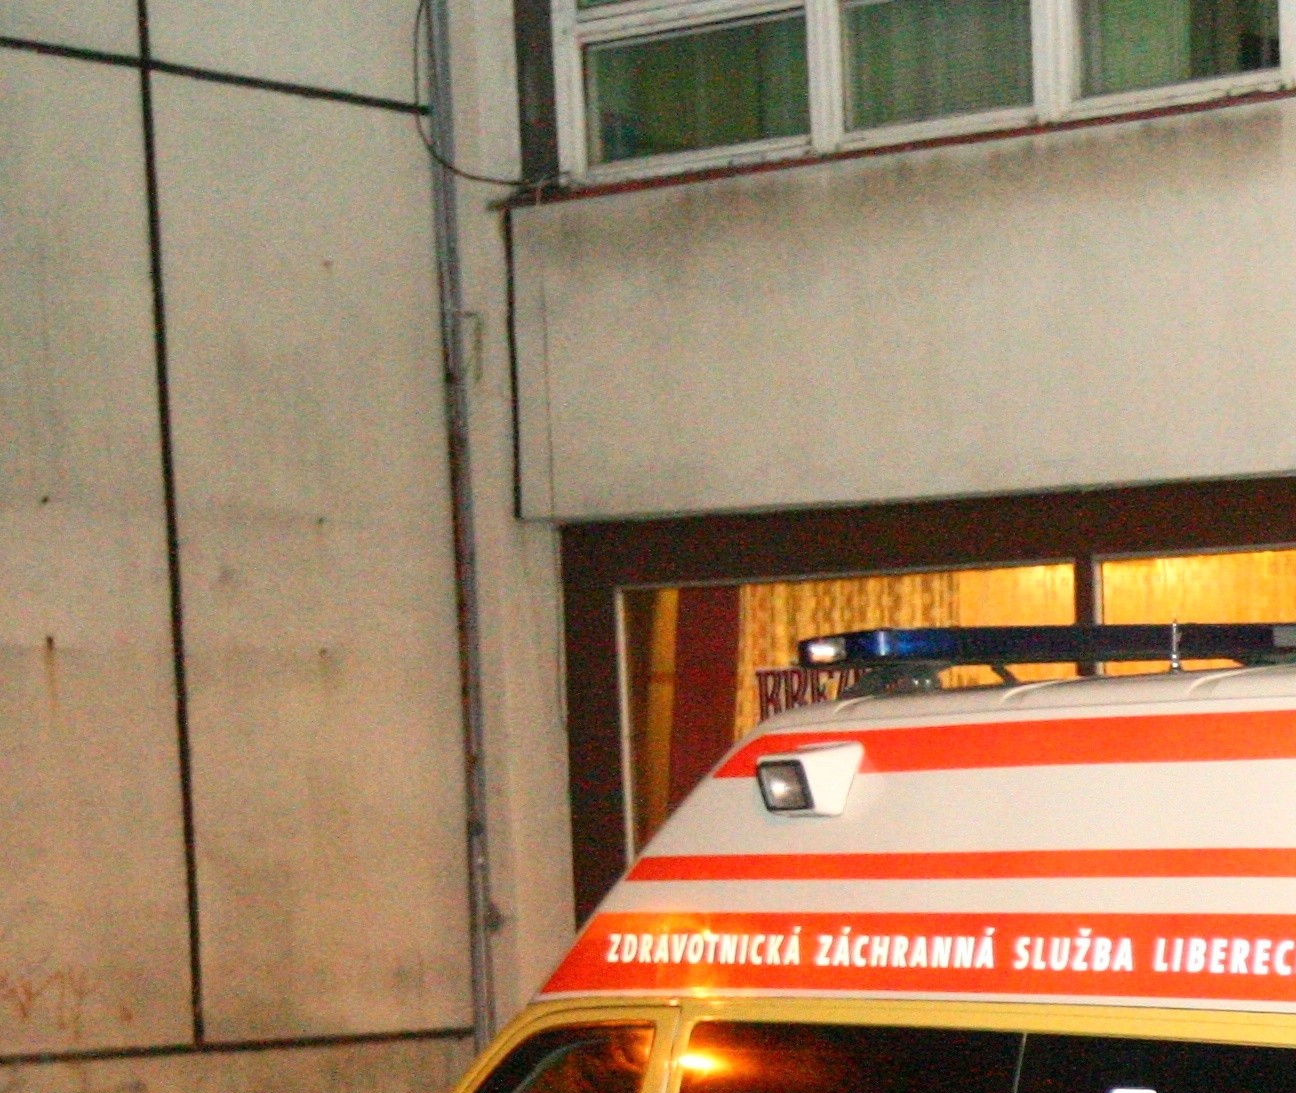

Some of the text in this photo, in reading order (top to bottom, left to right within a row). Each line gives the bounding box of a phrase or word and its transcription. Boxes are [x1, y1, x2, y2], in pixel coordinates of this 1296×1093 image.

[606, 926, 802, 965] ZDRAVOTNICKÁ
[814, 926, 996, 969] ZÁCHRANNÁ
[1013, 927, 1134, 972] SLUŽBA
